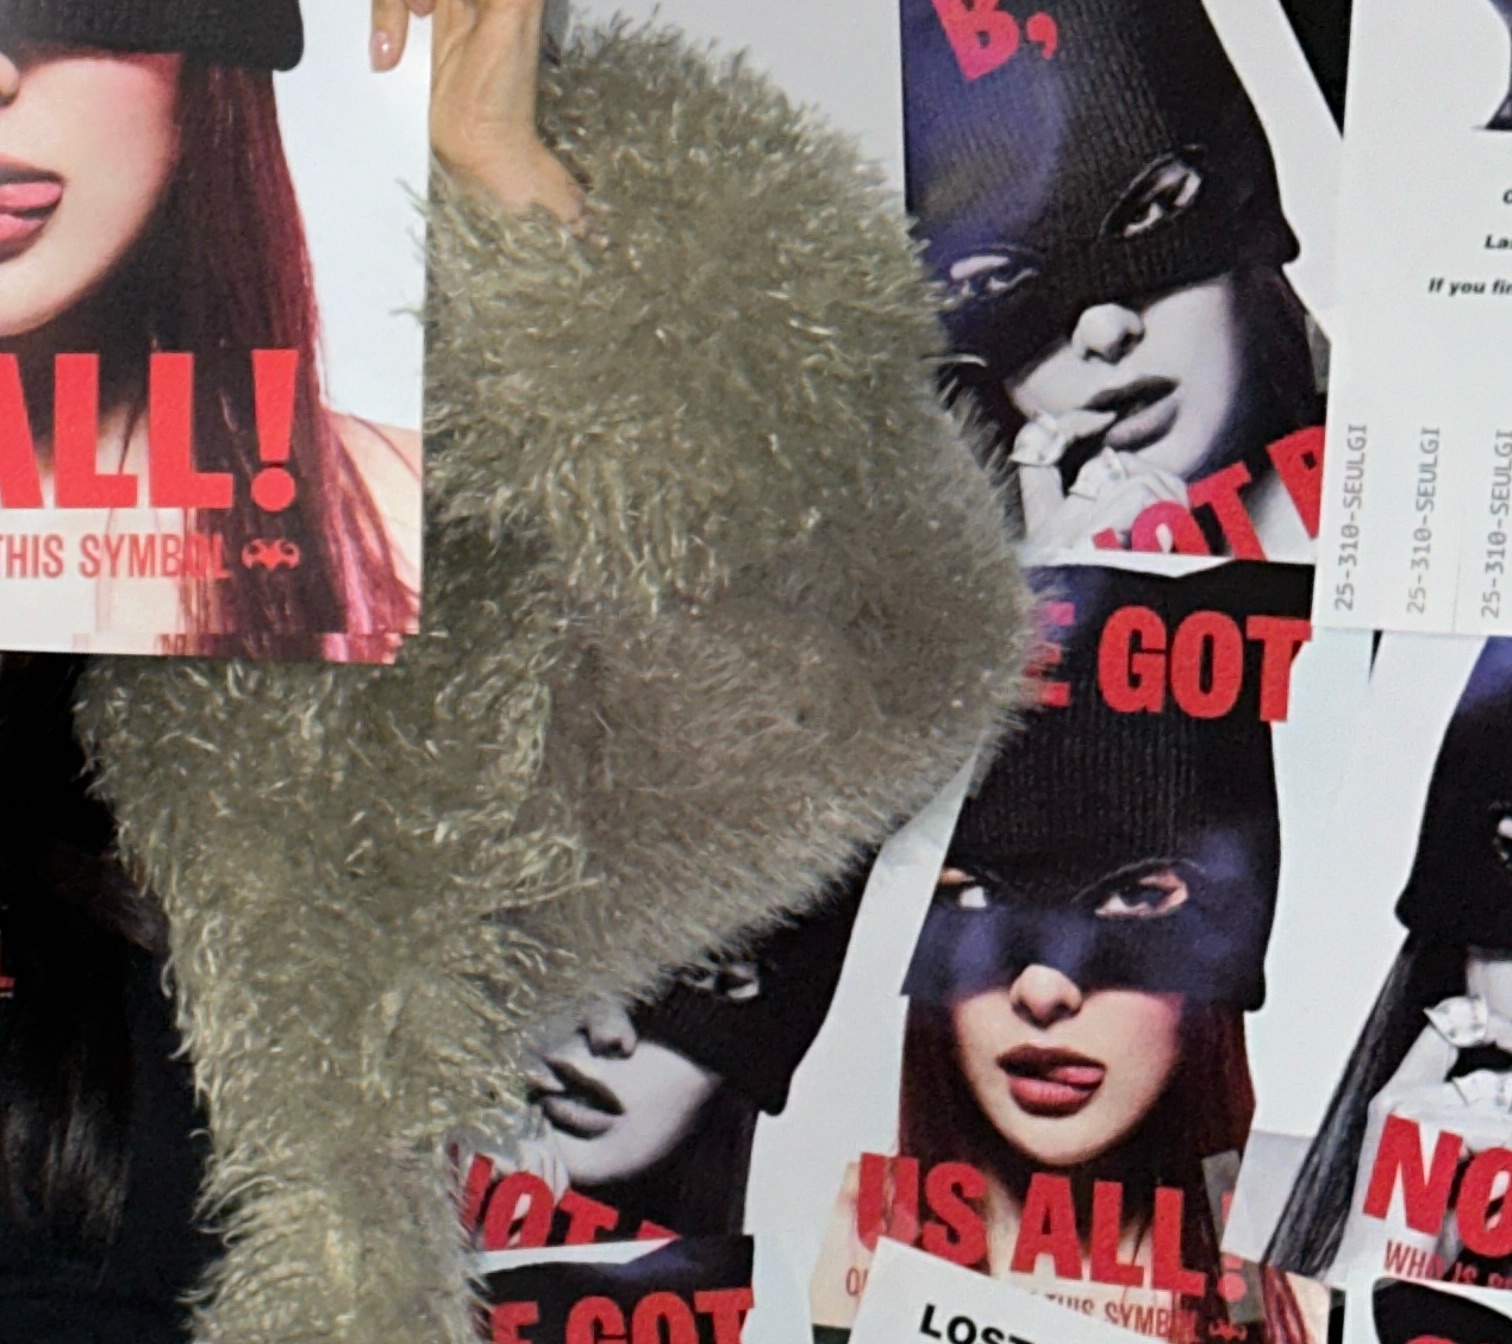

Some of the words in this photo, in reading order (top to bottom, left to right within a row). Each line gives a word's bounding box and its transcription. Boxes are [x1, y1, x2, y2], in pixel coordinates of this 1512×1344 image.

[1428, 277, 1444, 293] If
[1449, 282, 1486, 297] you
[78, 533, 231, 579] SYMBOL
[1334, 424, 1368, 612] 25-310-SEULGI
[1406, 427, 1440, 615] 25-310-SEULGI
[1097, 604, 1313, 723] GOT
[857, 1152, 988, 1264] US
